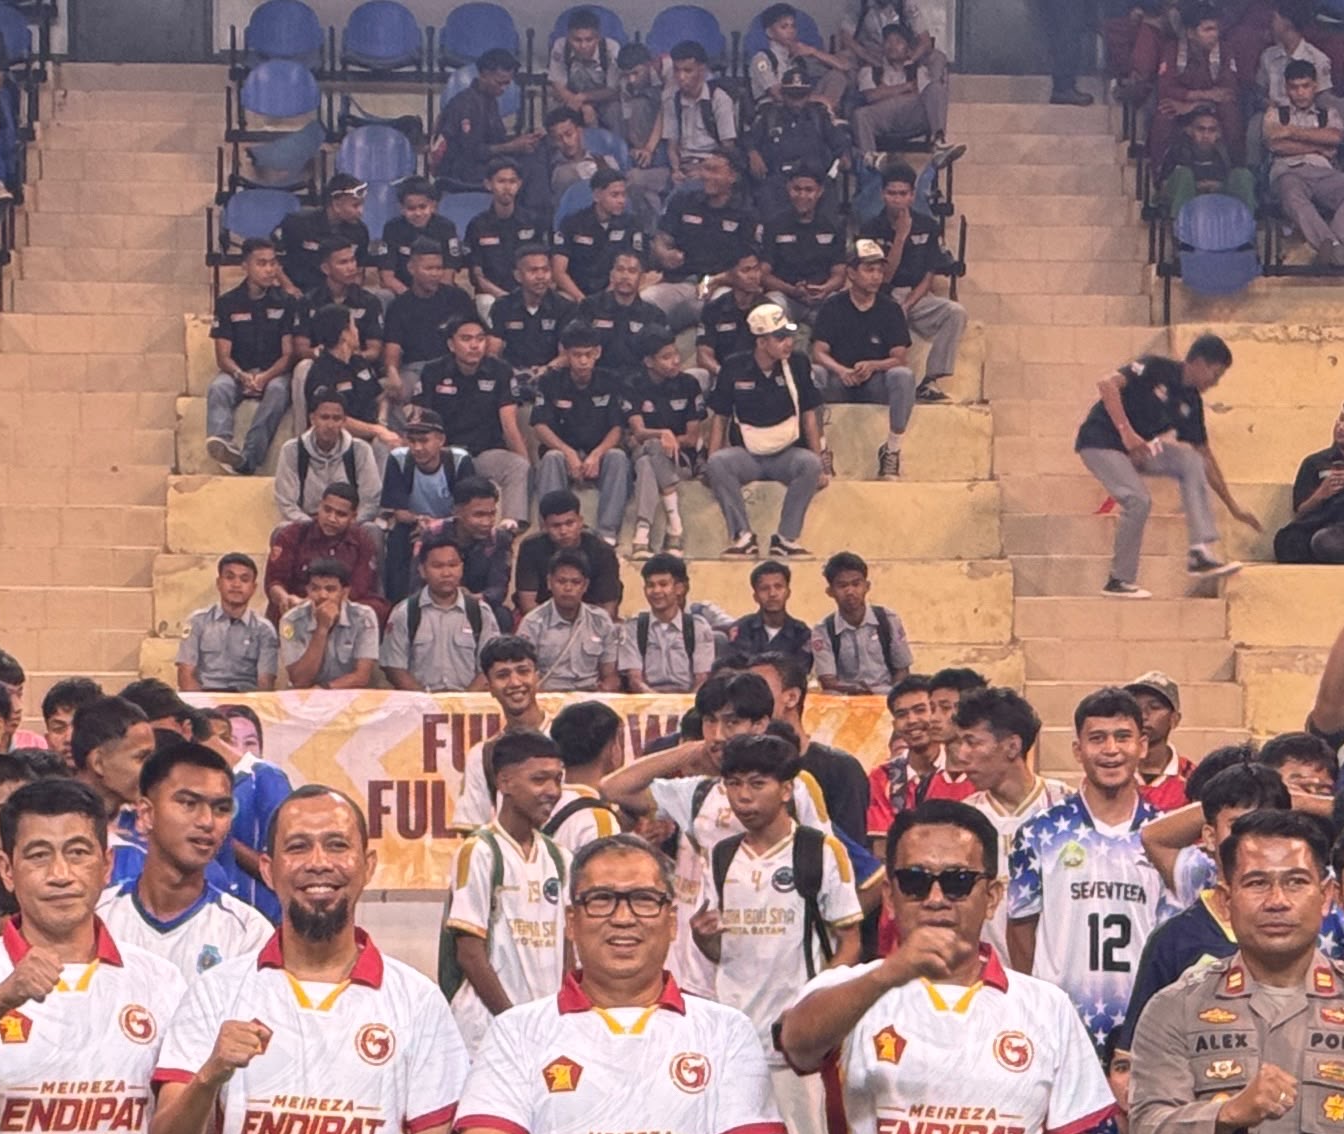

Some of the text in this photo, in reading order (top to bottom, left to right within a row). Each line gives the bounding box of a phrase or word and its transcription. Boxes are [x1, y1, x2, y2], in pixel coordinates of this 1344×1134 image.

[1088, 912, 1131, 973] 12
[1195, 1033, 1249, 1053] ALEX
[39, 1079, 126, 1095] MEIREZA
[271, 1094, 355, 1113] MEIREZA
[907, 1103, 997, 1121] MEIREZA
